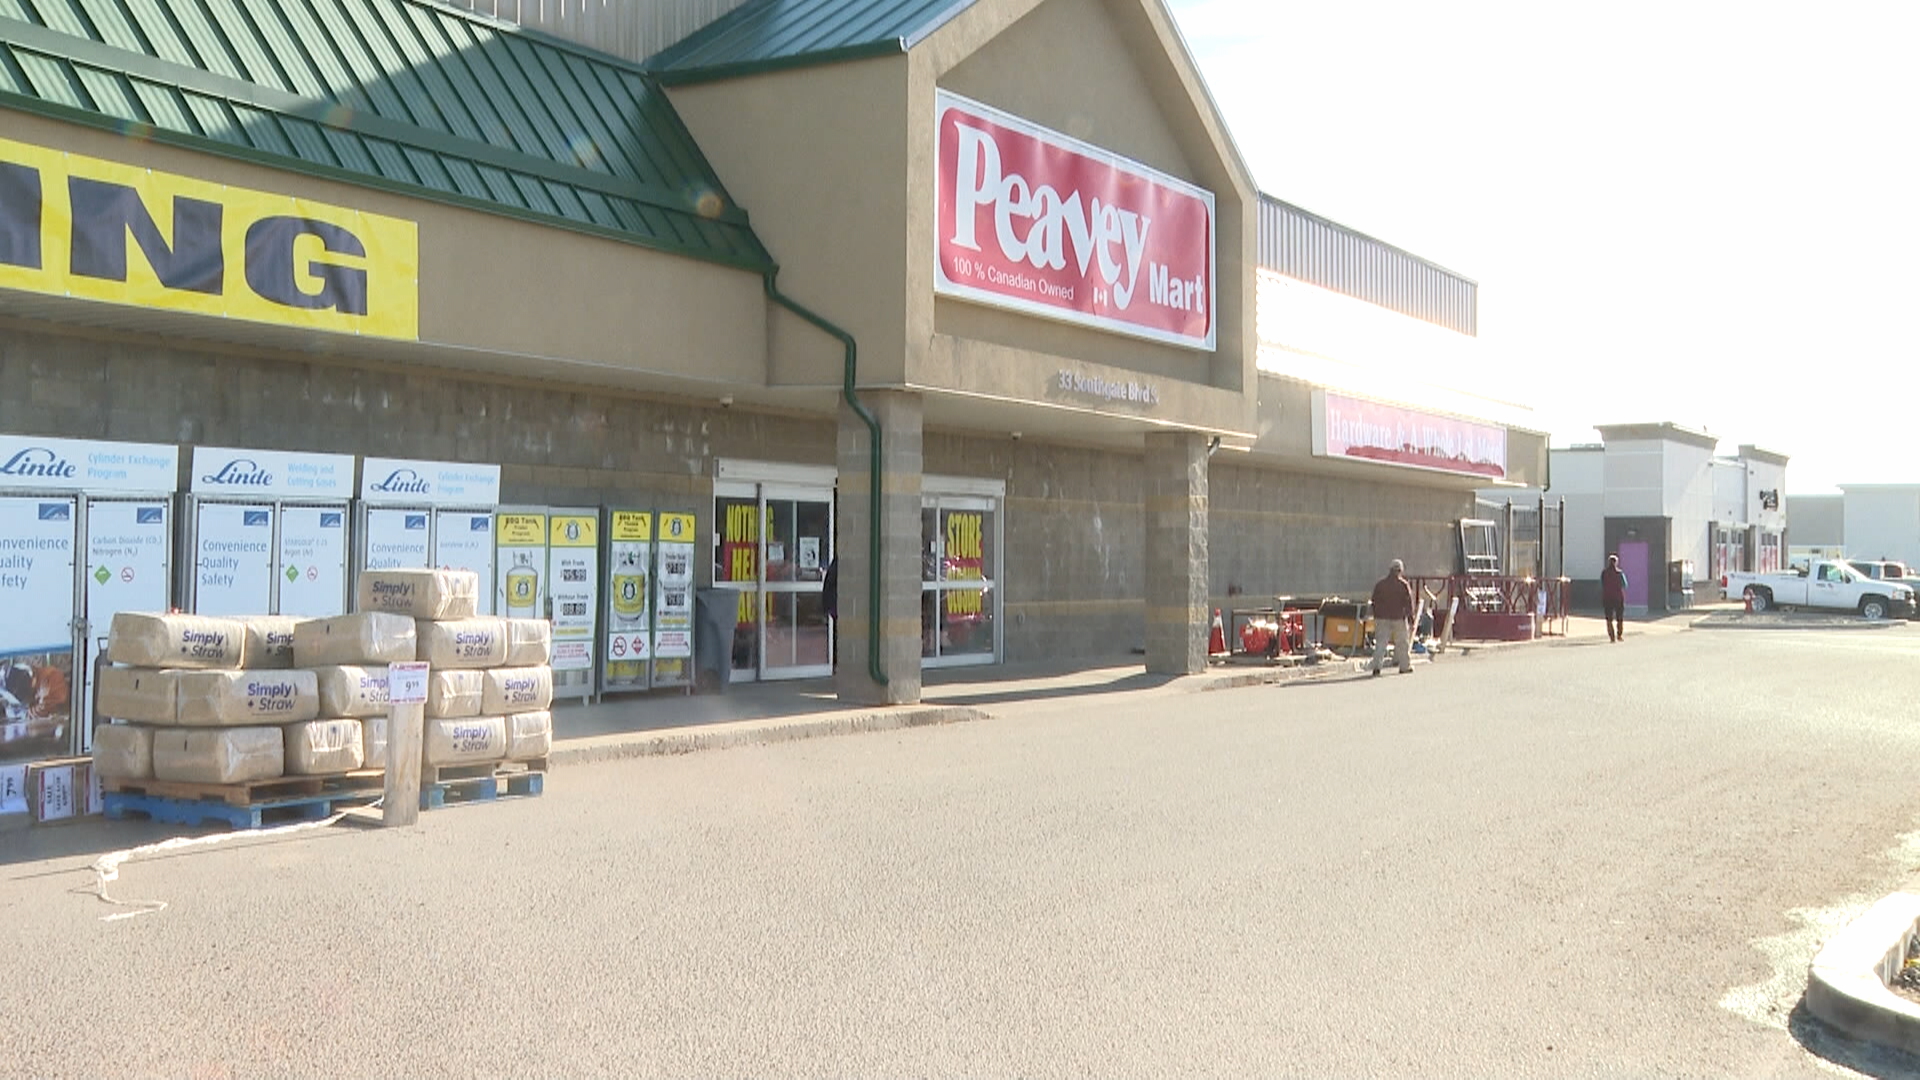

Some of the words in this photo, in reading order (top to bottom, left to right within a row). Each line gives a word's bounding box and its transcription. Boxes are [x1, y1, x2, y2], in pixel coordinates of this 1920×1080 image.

[951, 120, 1151, 310] Peavey
[953, 256, 972, 278] 100
[987, 265, 1037, 293] Canadian
[1038, 278, 1075, 300] Owned
[1149, 261, 1204, 314] Mart
[1058, 369, 1072, 389] 33
[1073, 371, 1127, 400] Southgate
[1128, 382, 1149, 402] Blvd
[1330, 408, 1391, 450] Hardware
[1409, 423, 1418, 454] A
[0, 447, 76, 478] Linde
[88, 454, 125, 467] Cylinder
[128, 456, 170, 469] Exchange
[87, 468, 127, 480] Program
[202, 459, 273, 486] Linde
[370, 468, 431, 494] Linde
[0, 535, 68, 550] nvenience
[947, 512, 982, 559] STORE
[93, 547, 122, 558] Nitrogen
[202, 540, 267, 552] Convenience
[371, 543, 425, 554] Convenience
[202, 556, 239, 570] Quality
[202, 573, 234, 588] Safety
[372, 581, 411, 597] Simply
[381, 596, 413, 609] Straw
[183, 630, 225, 646] Simply
[456, 632, 489, 648] Simply
[190, 645, 225, 659] Straw
[463, 646, 492, 657] Straw
[360, 676, 389, 690] Simpl
[504, 679, 536, 695] Simply
[247, 682, 293, 701] Simply
[511, 691, 537, 703] Straw
[259, 697, 296, 711] Straw
[453, 726, 487, 743] Simply
[461, 741, 490, 752] Straw
